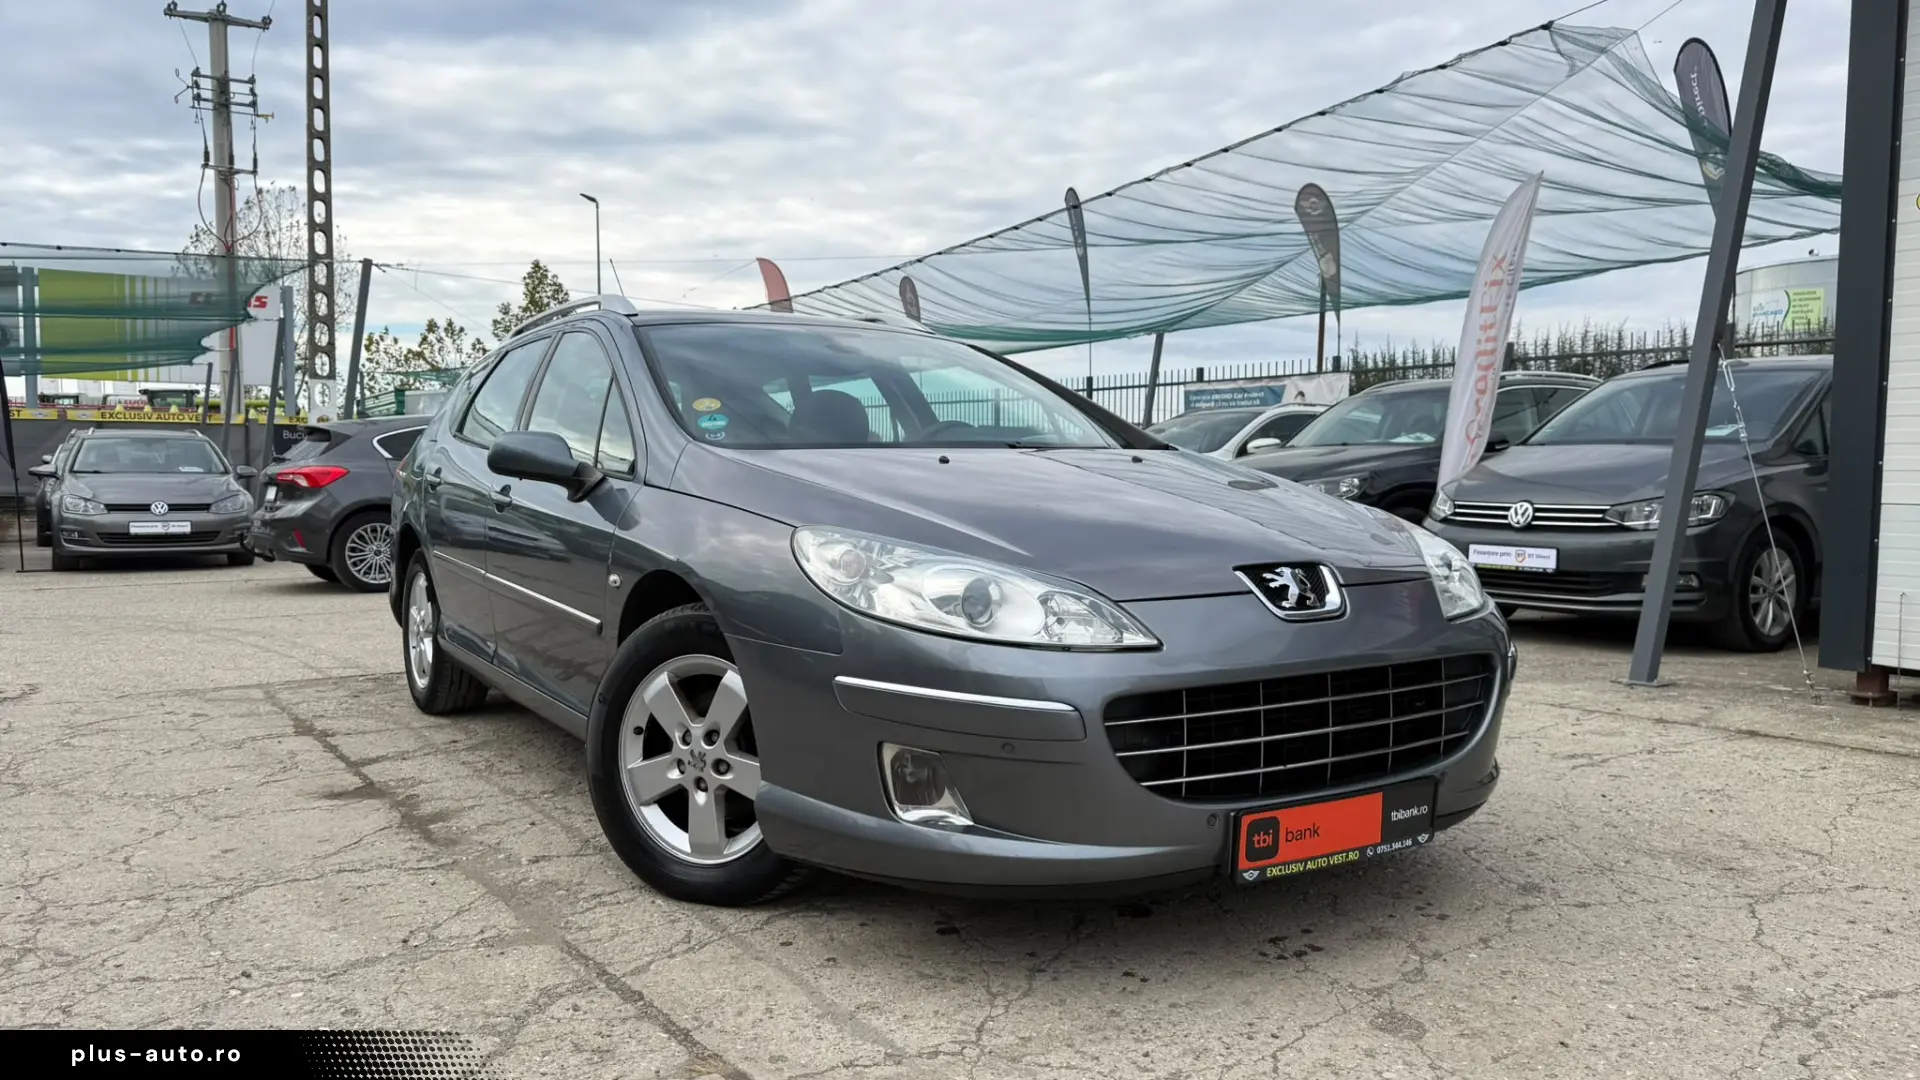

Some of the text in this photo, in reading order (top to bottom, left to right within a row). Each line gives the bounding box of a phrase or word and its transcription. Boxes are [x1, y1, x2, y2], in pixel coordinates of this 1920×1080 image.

[100, 412, 213, 422] EXCLUSIV AUTO VET
[1390, 804, 1428, 822] tbibank.ro
[1253, 828, 1273, 849] tbi
[1284, 822, 1320, 844] bank
[1266, 861, 1305, 877] EXCLUSIV
[1306, 858, 1328, 871] AUTO
[1329, 850, 1360, 865] VEST.RO
